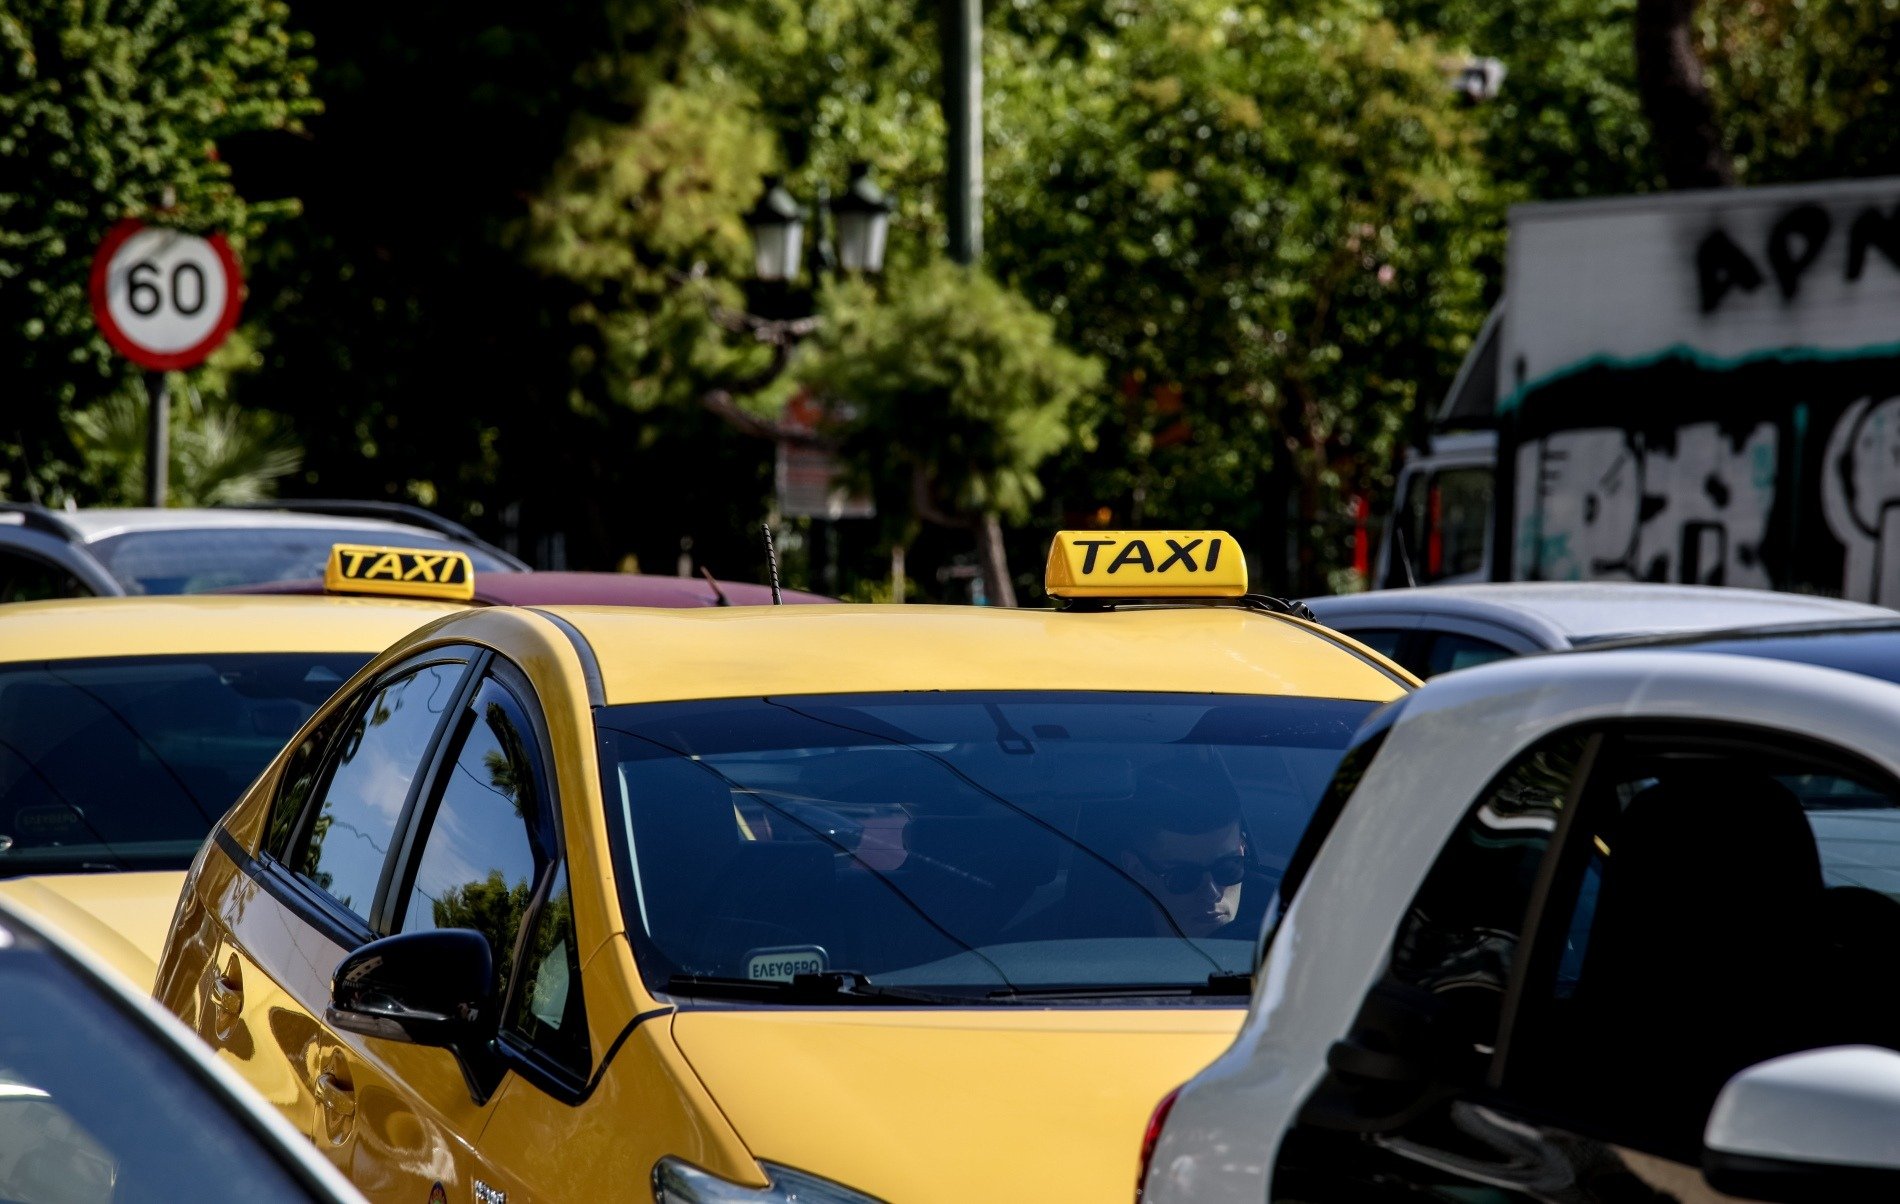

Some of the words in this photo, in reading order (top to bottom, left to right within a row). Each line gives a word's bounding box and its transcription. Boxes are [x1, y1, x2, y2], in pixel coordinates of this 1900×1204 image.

[127, 262, 206, 316] 60
[342, 551, 458, 583] TAXI
[1073, 538, 1222, 574] TAXI
